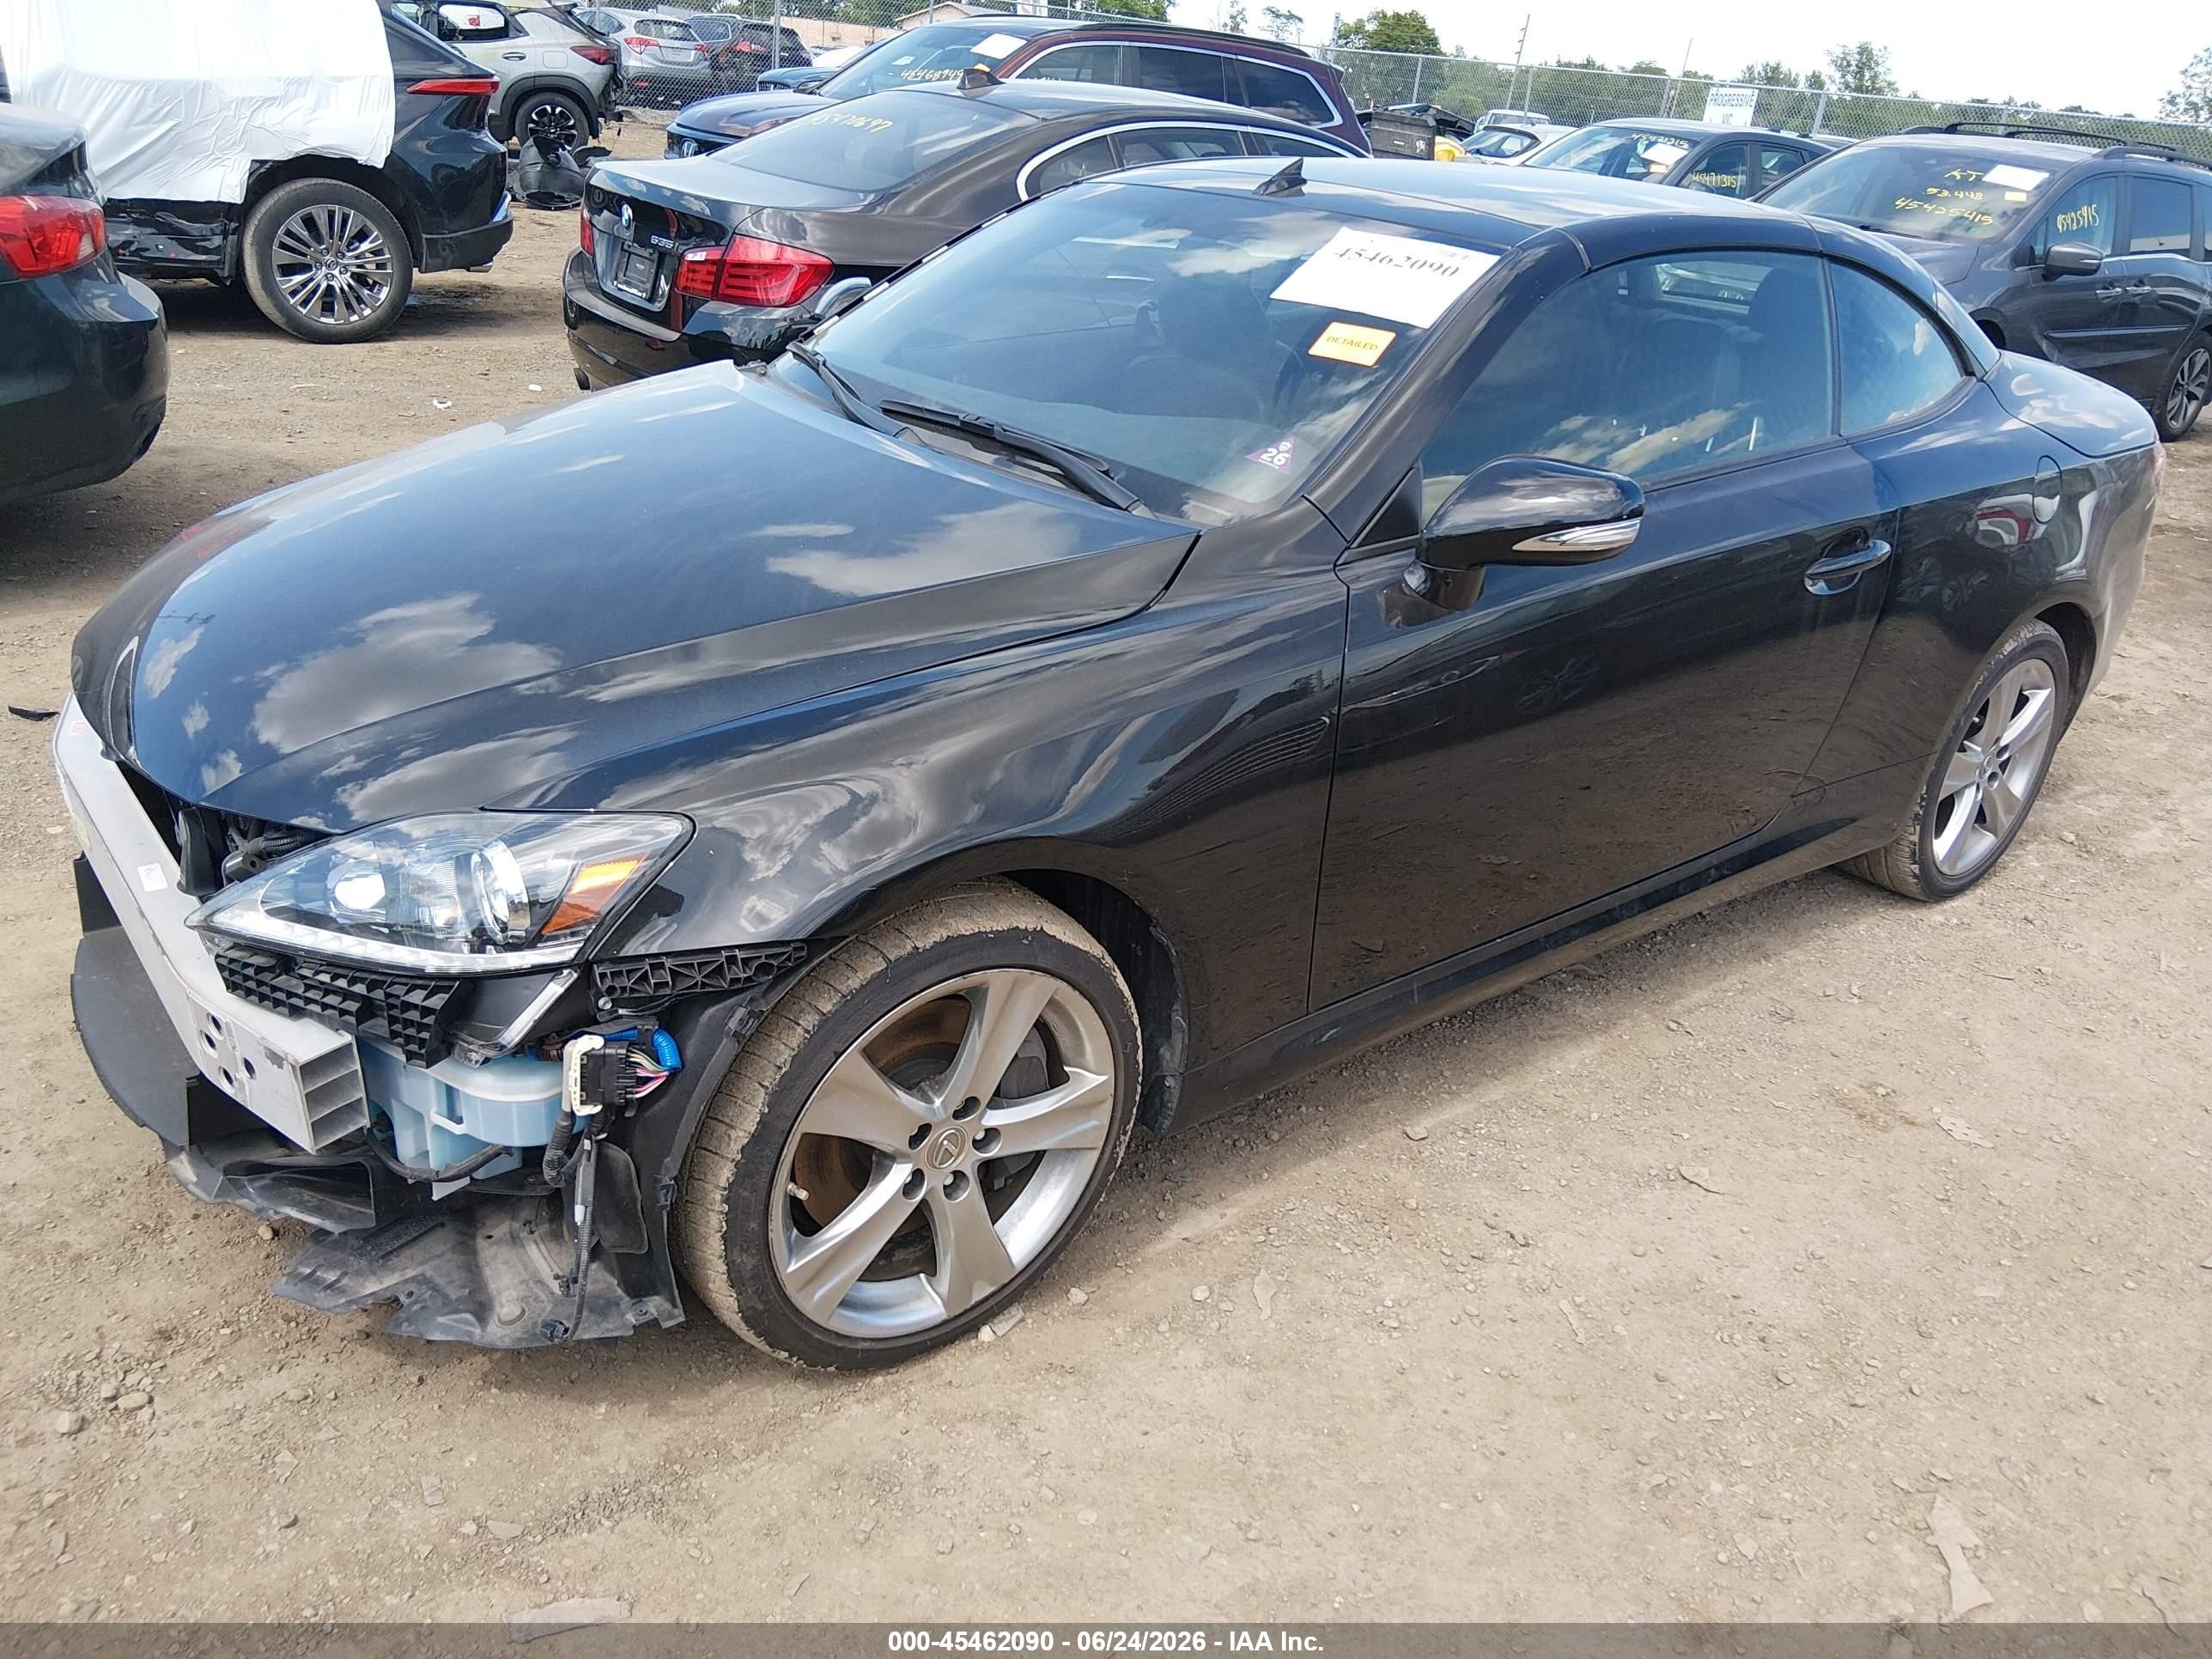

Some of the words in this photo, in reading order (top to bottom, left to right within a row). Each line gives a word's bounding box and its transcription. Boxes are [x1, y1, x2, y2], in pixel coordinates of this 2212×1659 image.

[1708, 93, 1755, 108] PROGRESSIVE
[1692, 172, 1737, 188] 45471315
[1895, 198, 1993, 225] 45425415
[1334, 247, 1460, 276] 45462090
[1326, 336, 1378, 351] DETAILED
[1260, 447, 1291, 465] 26
